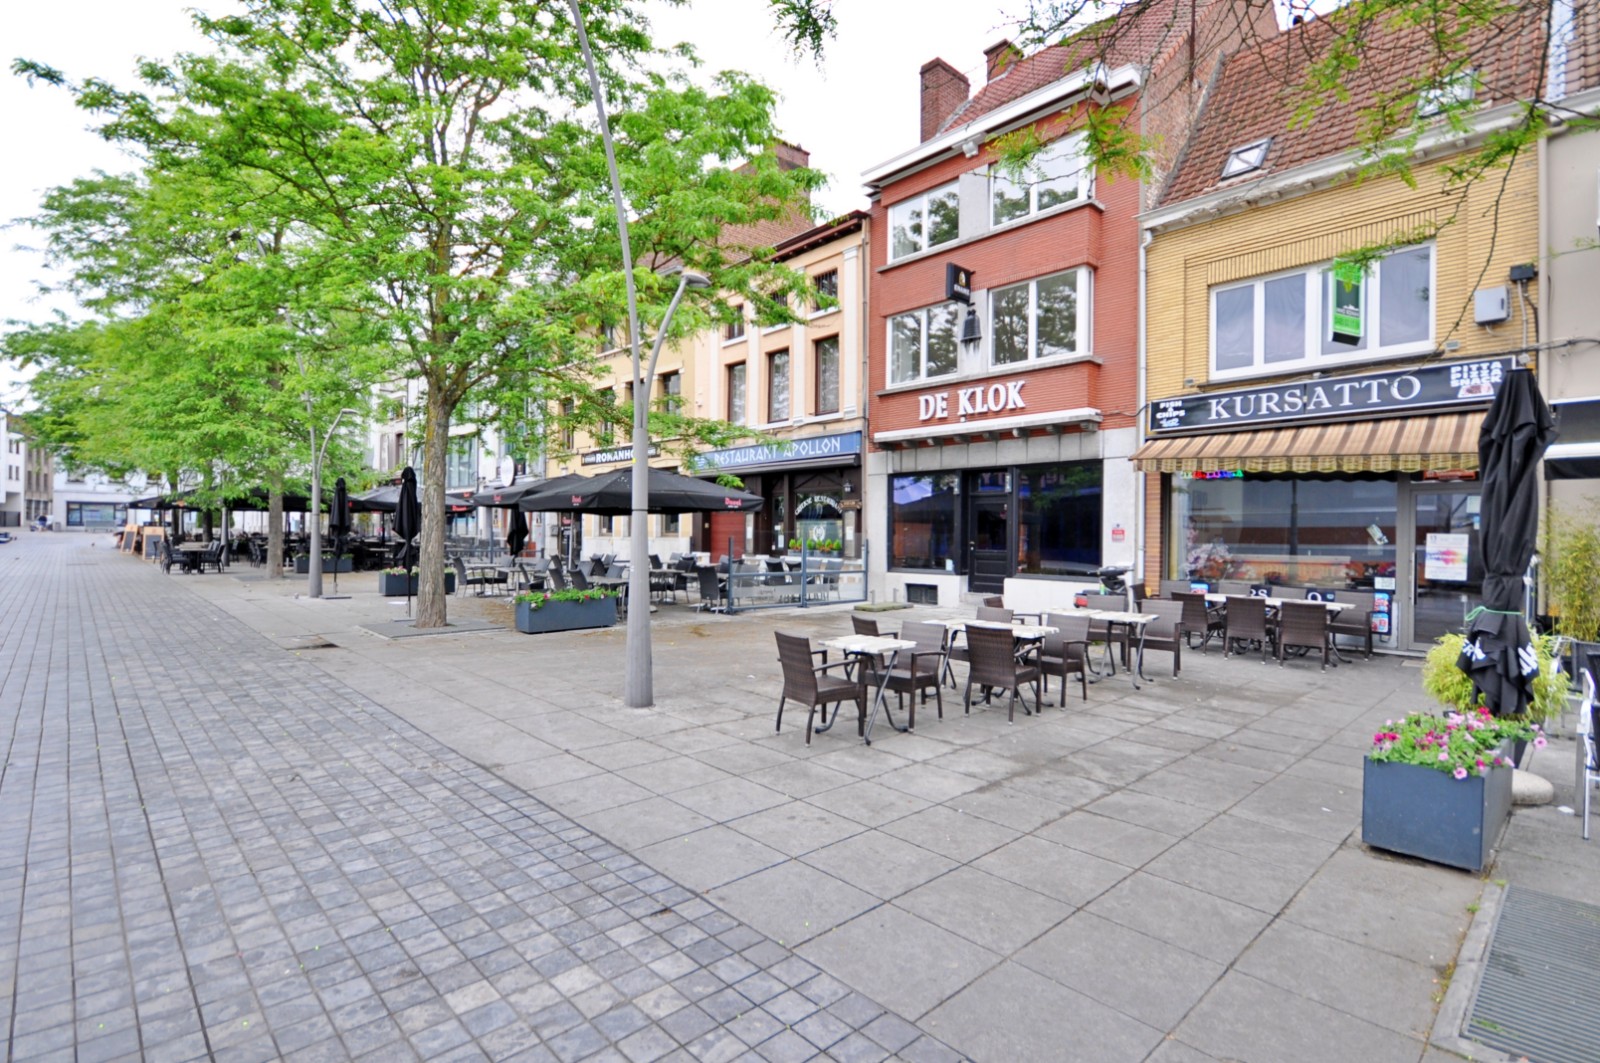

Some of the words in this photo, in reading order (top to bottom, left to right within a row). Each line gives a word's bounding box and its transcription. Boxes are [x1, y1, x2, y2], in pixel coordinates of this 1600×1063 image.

[1450, 361, 1502, 373] PITTA
[1450, 368, 1502, 380] PIZZA
[1450, 375, 1502, 387] SNACK
[918, 392, 949, 421] DE
[957, 380, 1026, 416] KLOK
[1207, 375, 1422, 420] KURSATTO
[1160, 400, 1183, 409] FISH
[1155, 409, 1186, 419] CHIPS
[714, 444, 778, 465] RESTAURANT
[783, 436, 841, 457] APOLLON
